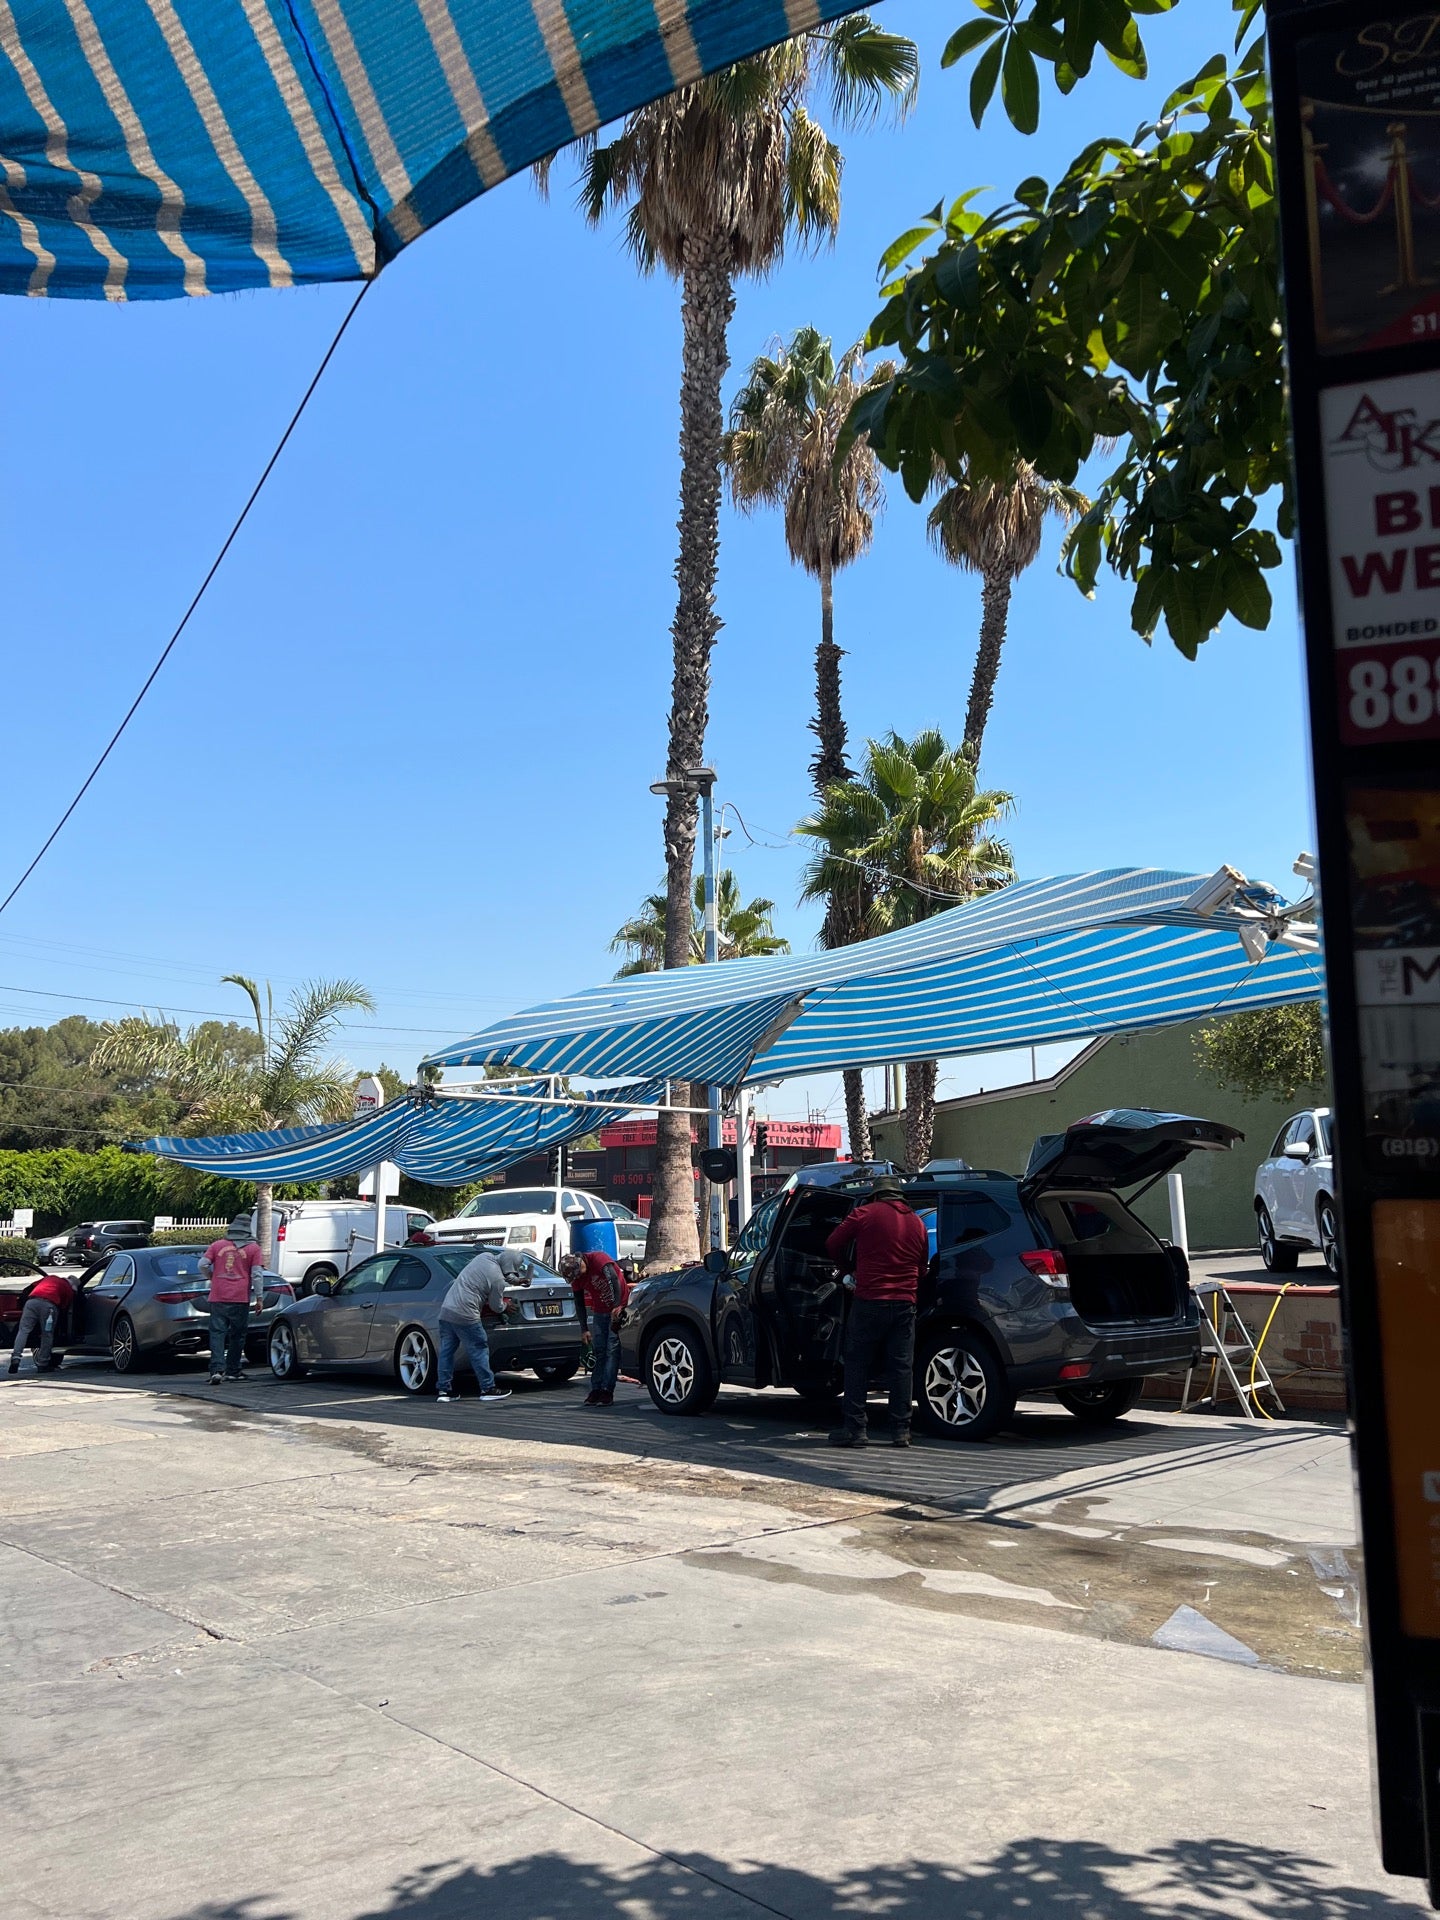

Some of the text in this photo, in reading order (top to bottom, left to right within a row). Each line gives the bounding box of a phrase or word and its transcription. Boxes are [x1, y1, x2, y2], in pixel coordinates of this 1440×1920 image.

[1346, 618, 1437, 641] BONDED
[1348, 655, 1440, 730] 88
[1381, 1137, 1439, 1158] (818)
[612, 1174, 626, 1185] 818
[627, 1173, 643, 1185] 509
